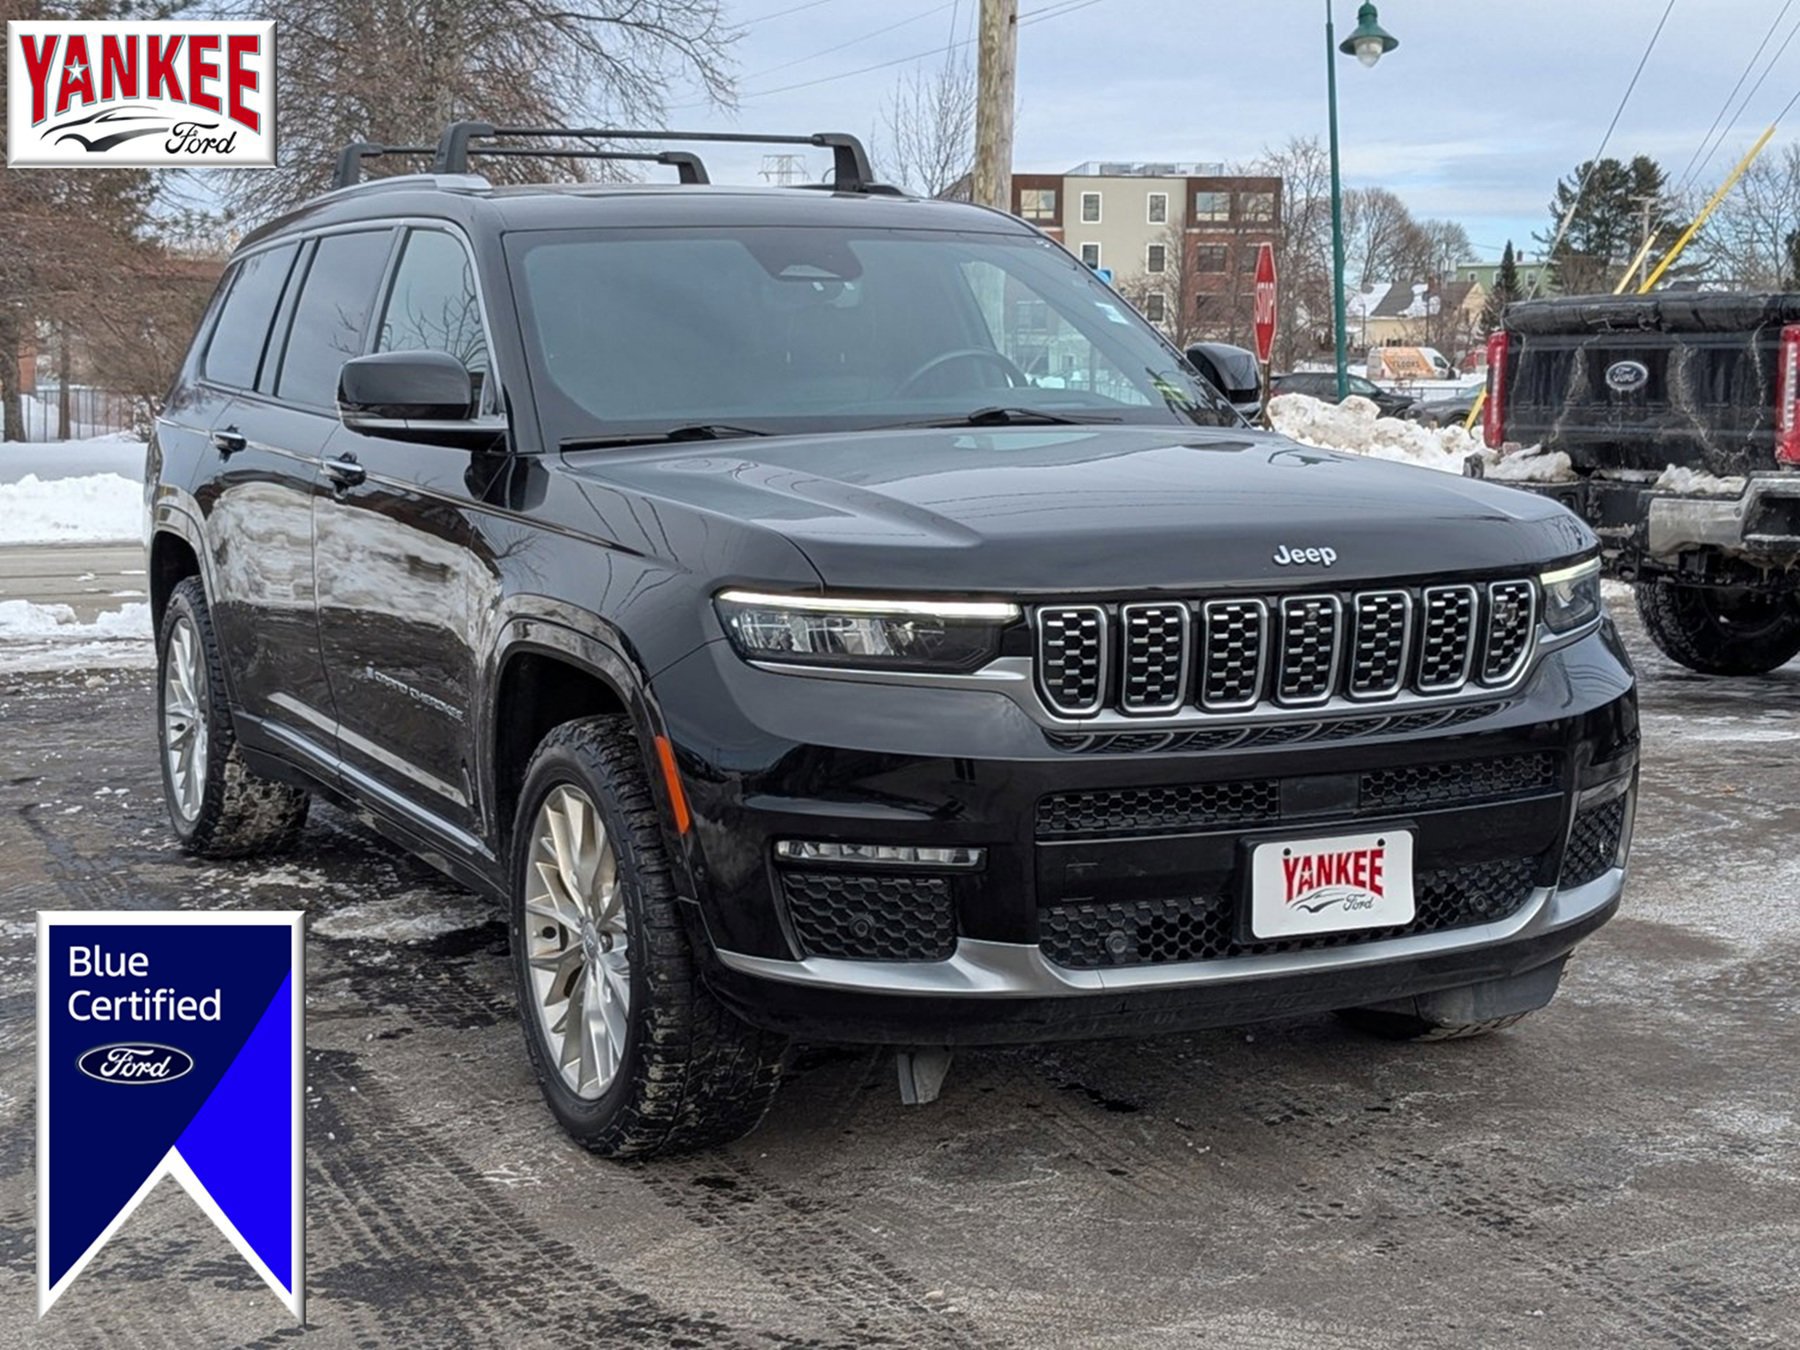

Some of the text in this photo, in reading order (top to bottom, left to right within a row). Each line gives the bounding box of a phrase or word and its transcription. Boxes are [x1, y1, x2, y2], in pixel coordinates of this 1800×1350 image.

[1273, 545, 1337, 566] Jeep
[1282, 848, 1385, 904] YANKEE
[1342, 893, 1374, 912] Ford
